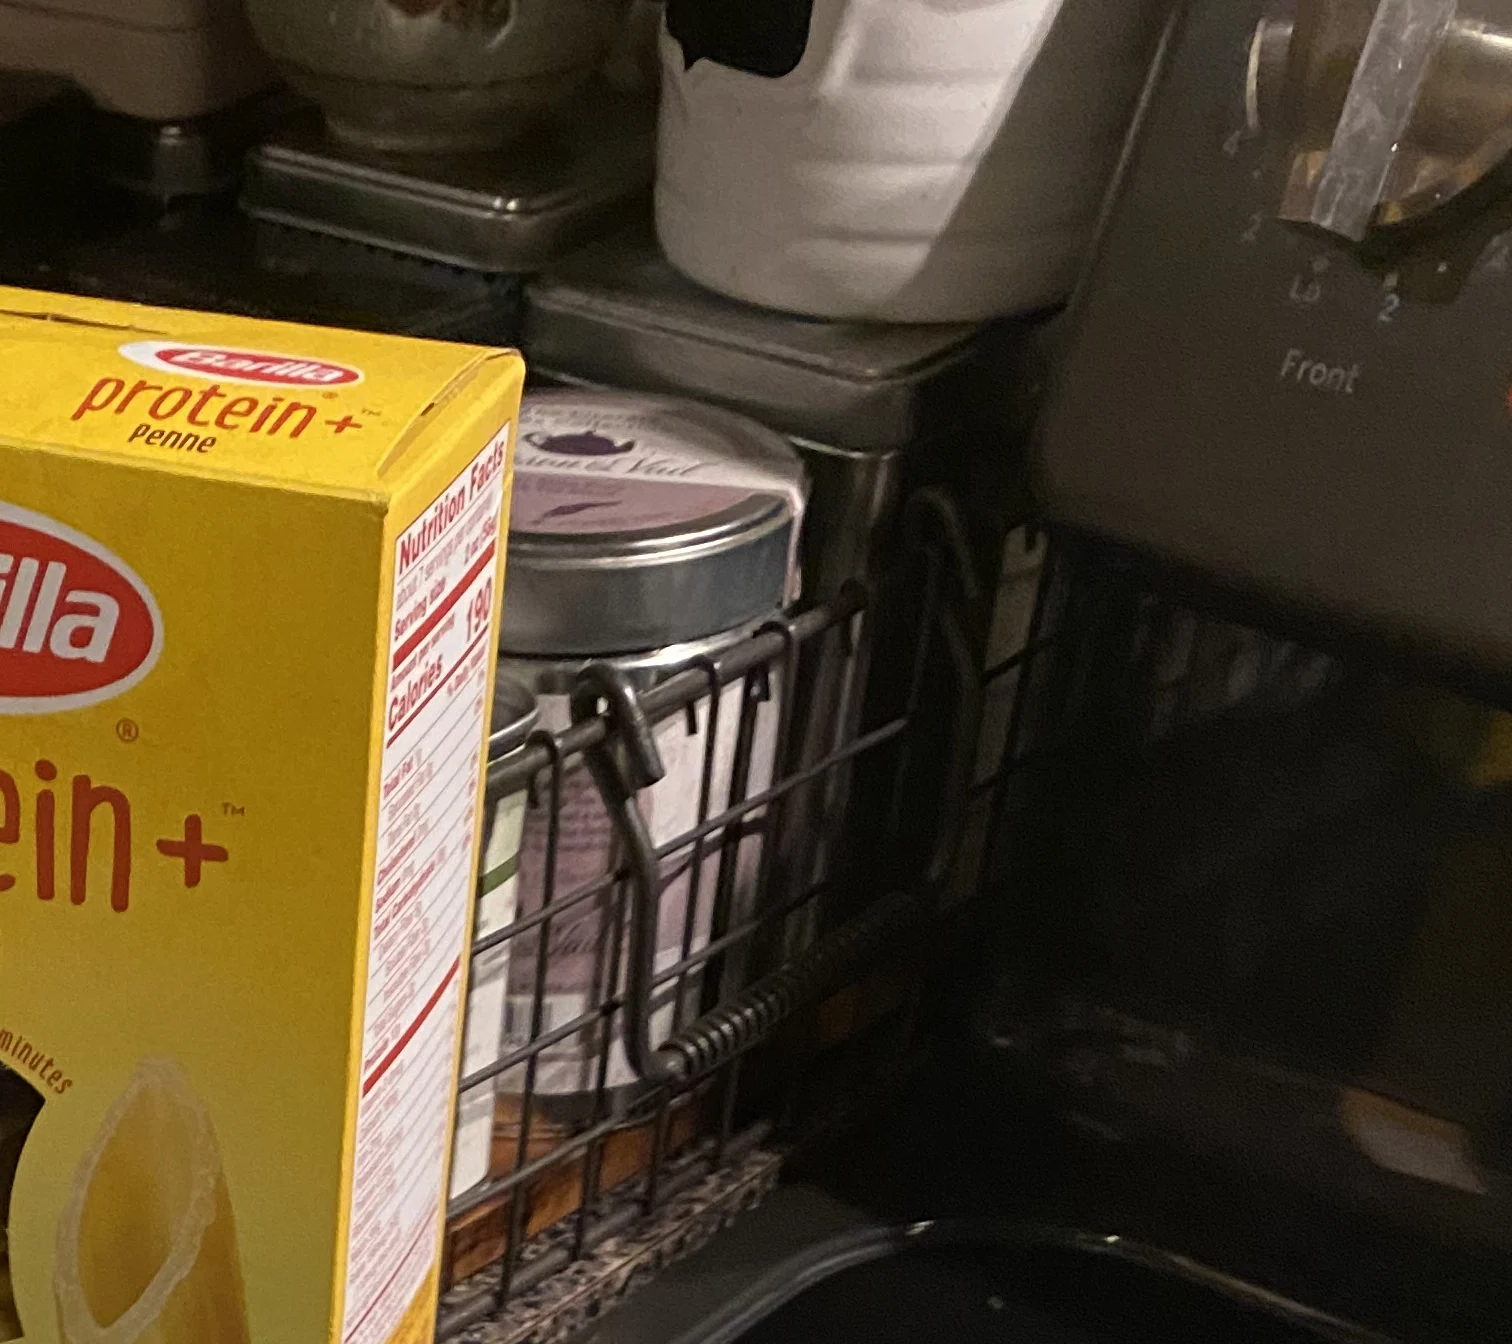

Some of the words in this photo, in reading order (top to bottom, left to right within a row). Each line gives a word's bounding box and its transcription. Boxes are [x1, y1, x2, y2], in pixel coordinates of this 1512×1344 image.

[169, 350, 344, 381] Barilla
[1280, 348, 1360, 393] Front
[127, 423, 217, 453] Penne
[400, 485, 466, 575] Nutrition
[470, 441, 504, 500] Facts
[388, 653, 443, 733] Calories
[467, 576, 493, 643] 190
